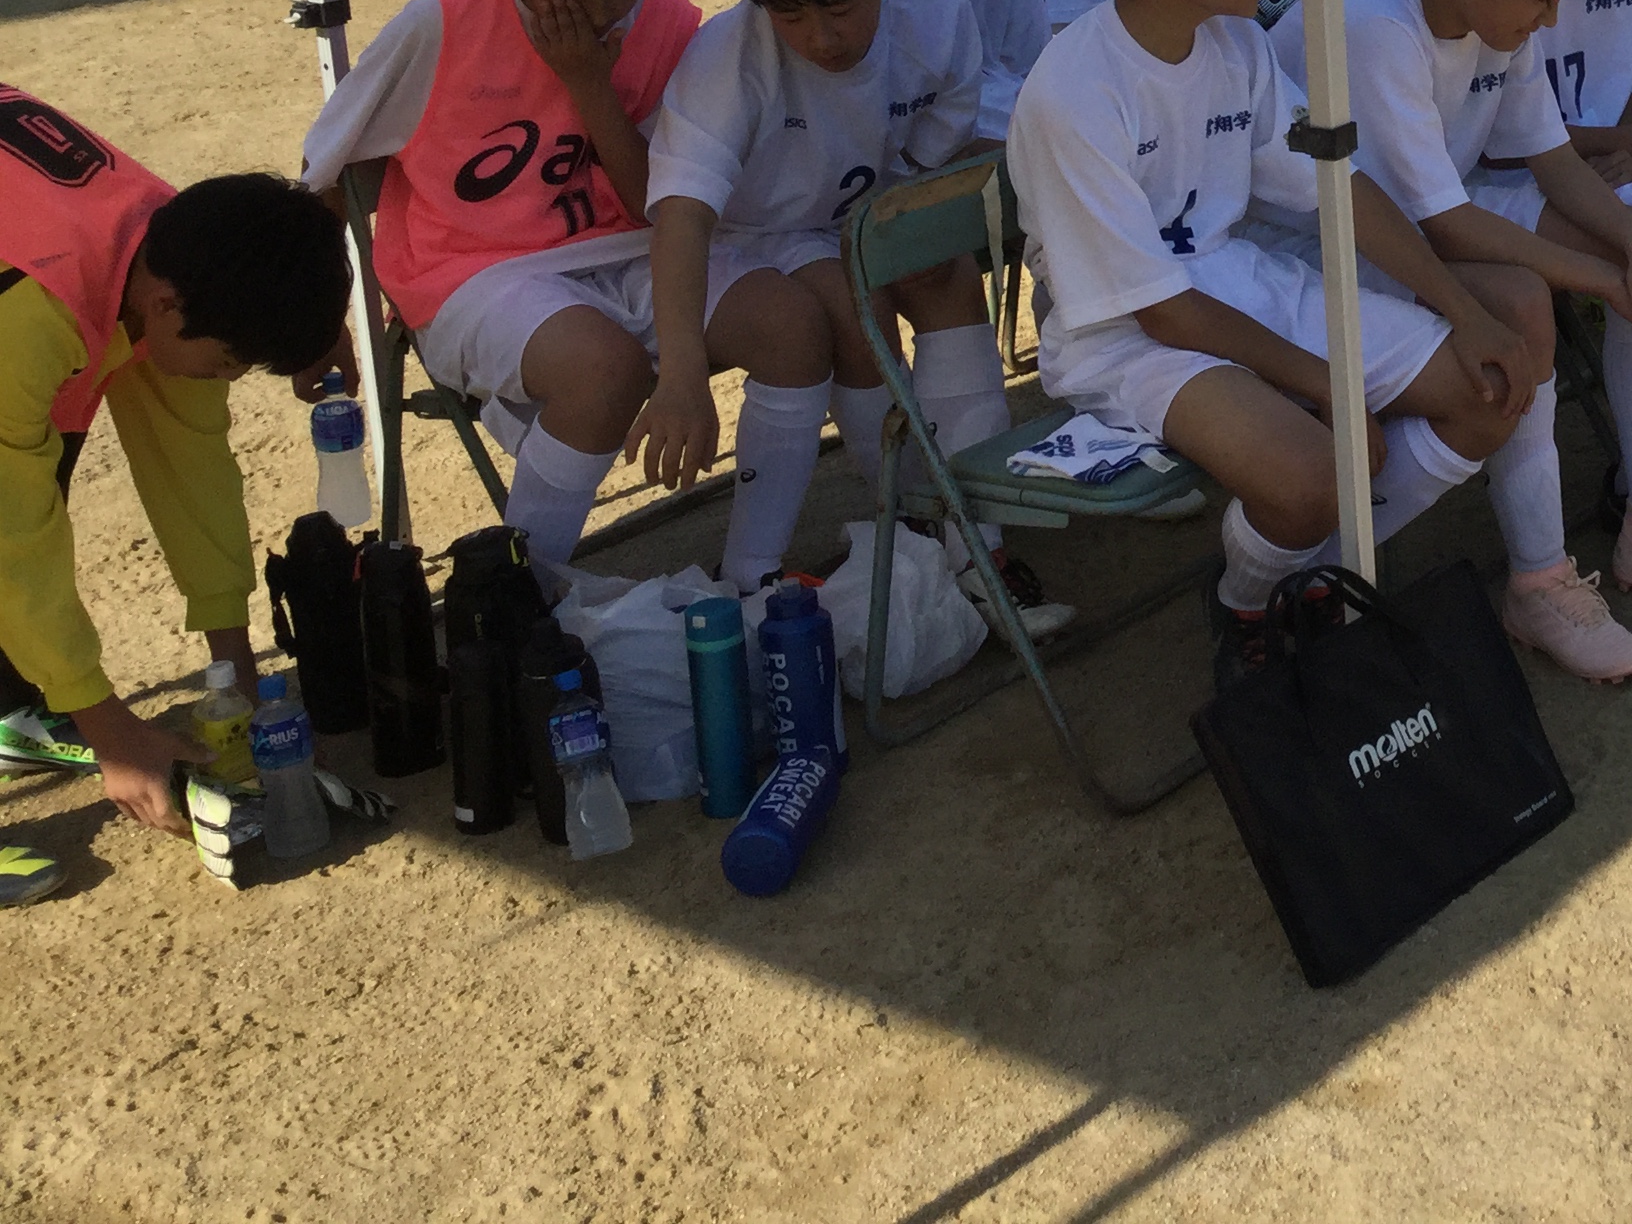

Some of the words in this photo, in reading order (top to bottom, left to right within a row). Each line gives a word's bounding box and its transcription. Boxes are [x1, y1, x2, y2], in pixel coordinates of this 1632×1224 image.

[831, 165, 877, 221] 2
[1159, 188, 1198, 255] 4
[1349, 707, 1438, 779] molten
[1357, 732, 1442, 789] SOCCER
[760, 758, 808, 813] SWEAT
[777, 760, 827, 829] POCARI
